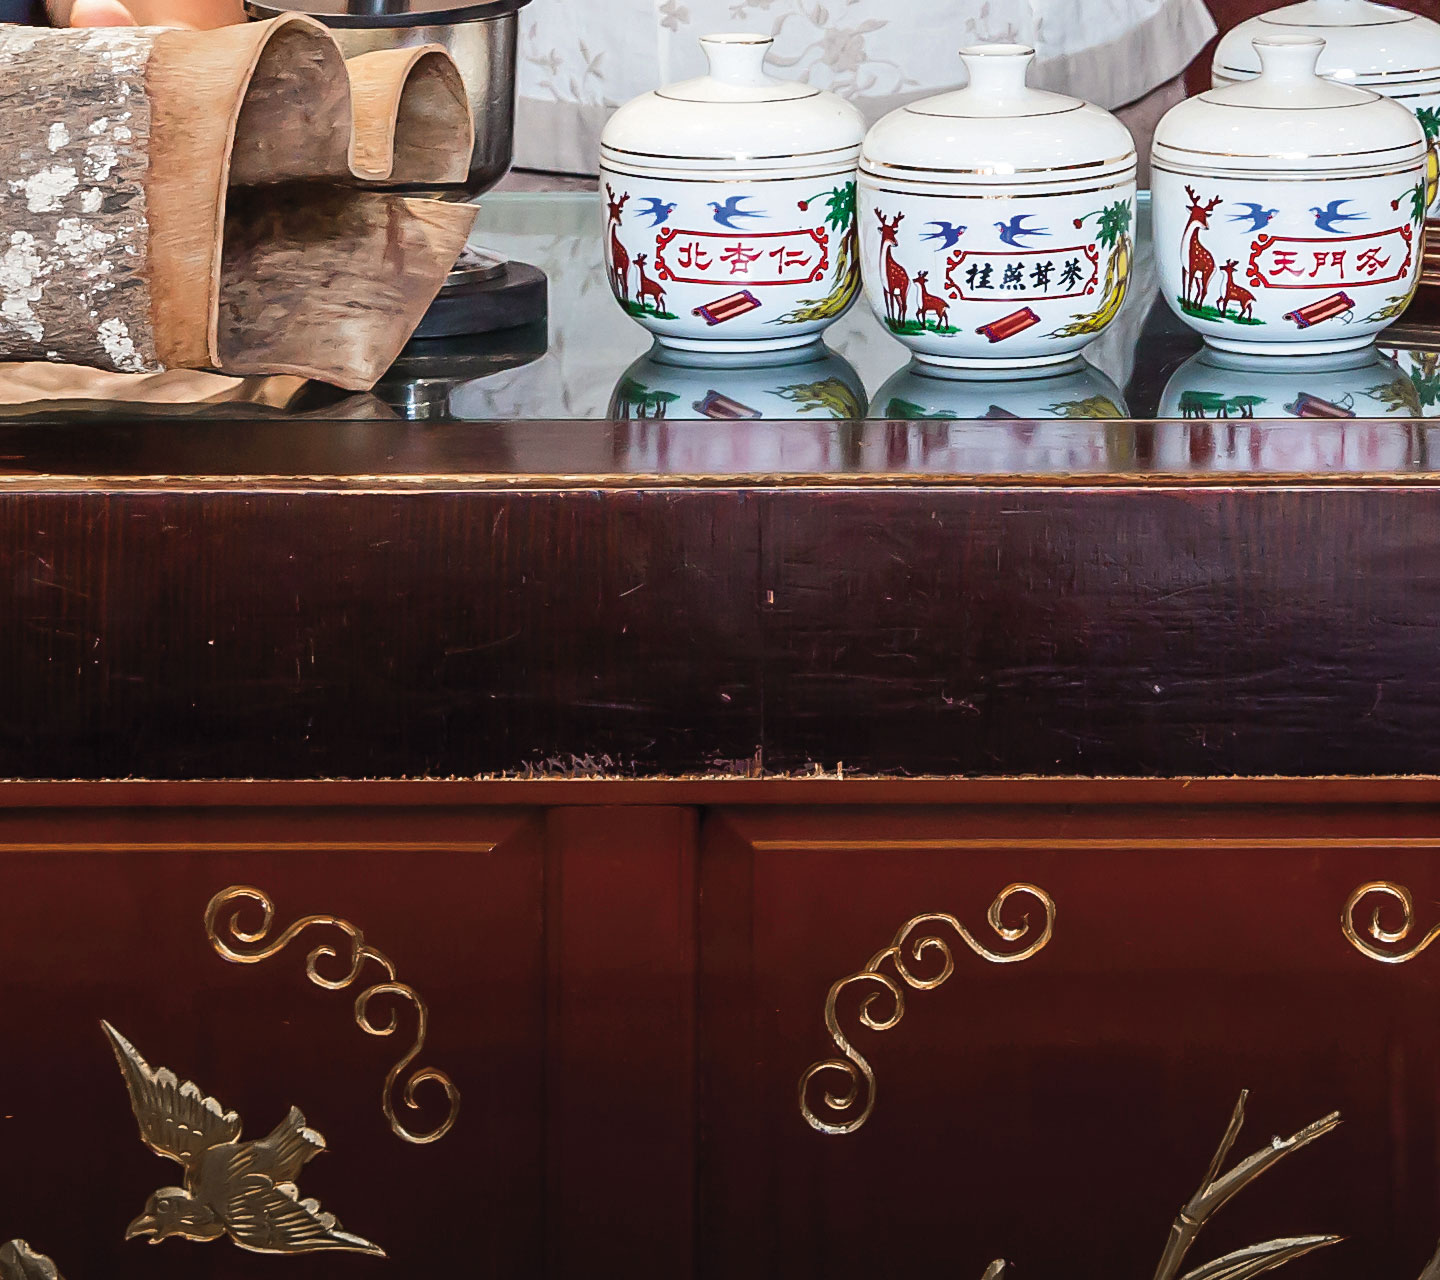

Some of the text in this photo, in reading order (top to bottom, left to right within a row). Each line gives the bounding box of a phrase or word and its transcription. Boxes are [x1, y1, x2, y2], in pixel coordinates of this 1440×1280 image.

[678, 242, 812, 274] 北杏仁
[1269, 246, 1391, 279] 天門冬
